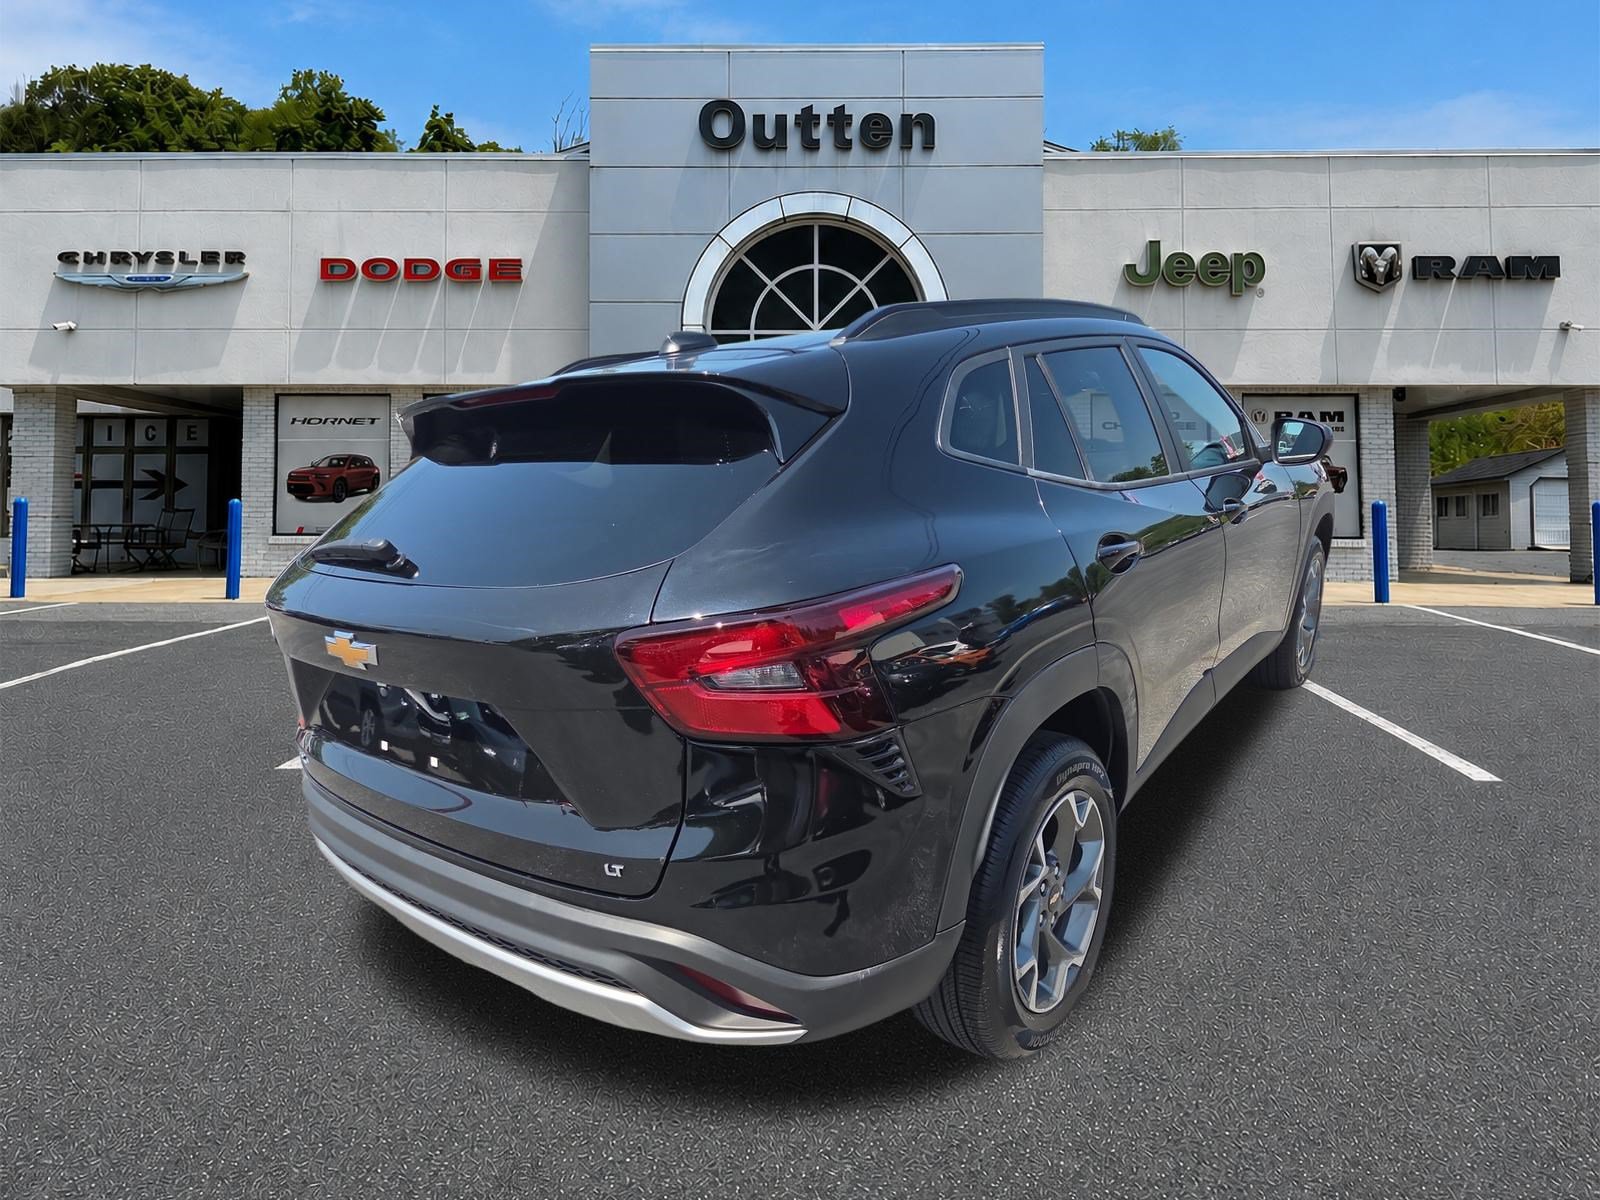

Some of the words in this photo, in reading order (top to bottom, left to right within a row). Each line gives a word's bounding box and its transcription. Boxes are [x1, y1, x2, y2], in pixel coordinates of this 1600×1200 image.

[699, 98, 936, 150] Outten
[57, 250, 246, 265] CHRYSLER
[1411, 255, 1561, 280] RAM
[320, 257, 523, 282] DODGE
[1123, 239, 1266, 297] Jeep
[290, 417, 381, 426] HORNET
[1274, 411, 1344, 422] RAM
[603, 863, 625, 878] LT
